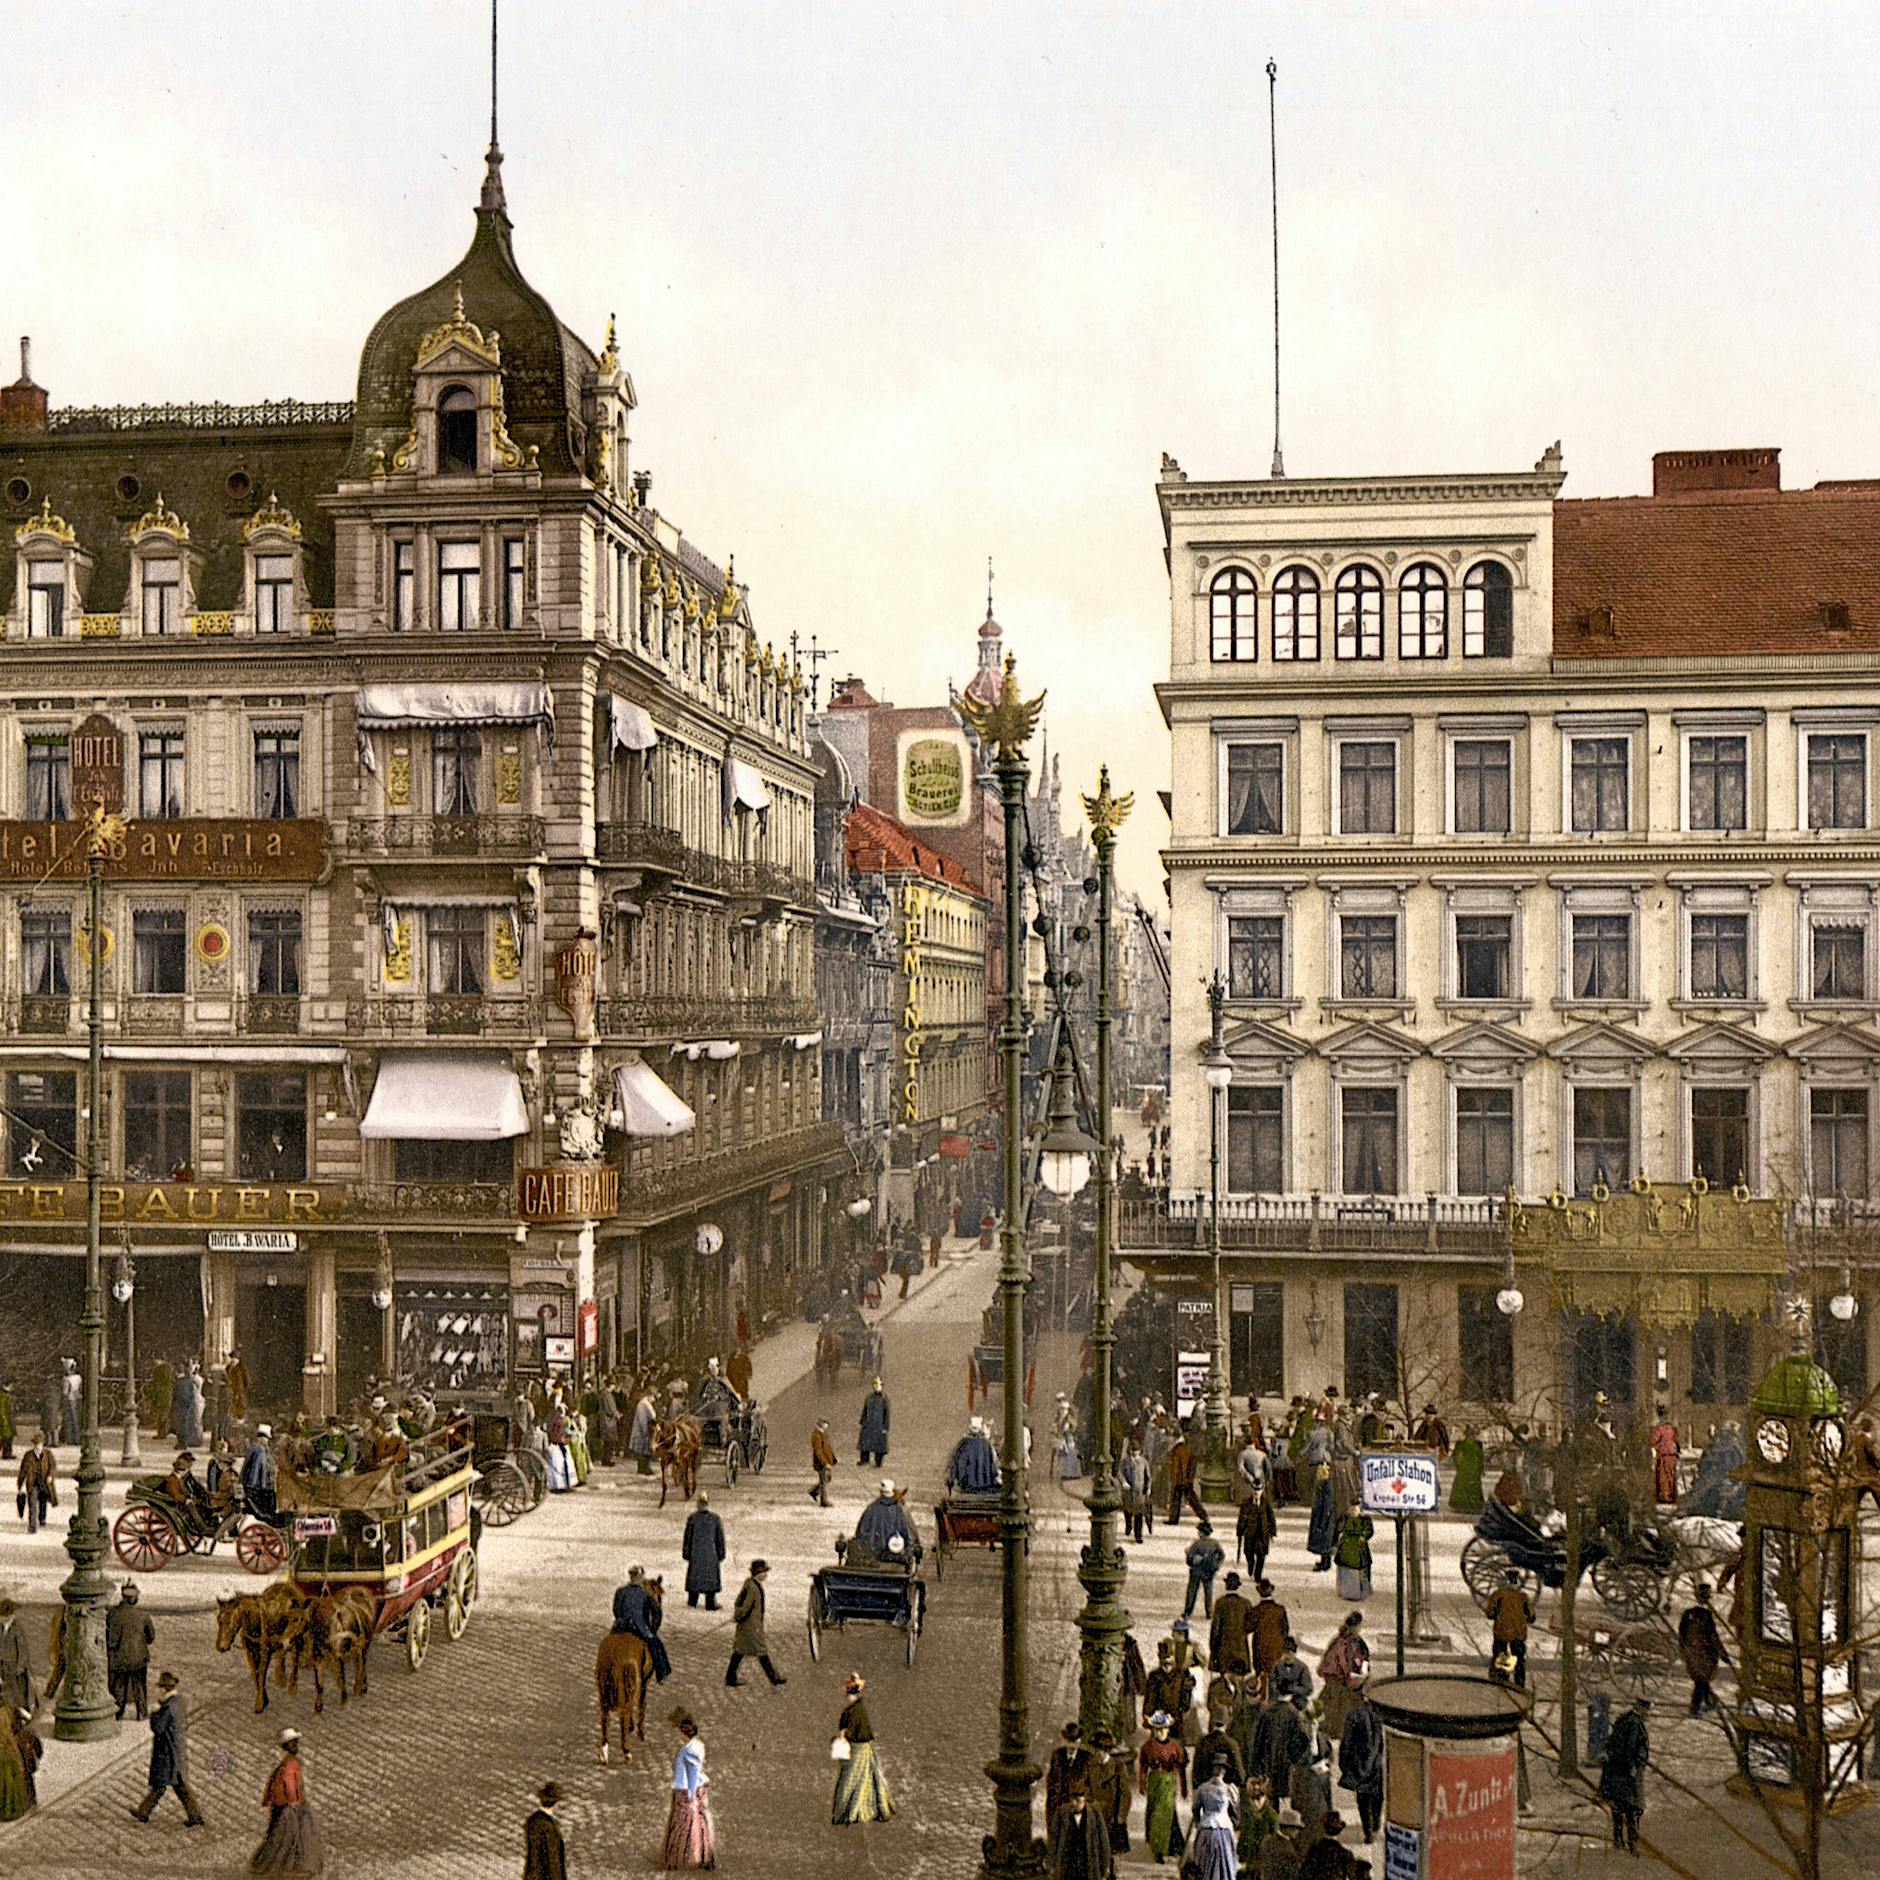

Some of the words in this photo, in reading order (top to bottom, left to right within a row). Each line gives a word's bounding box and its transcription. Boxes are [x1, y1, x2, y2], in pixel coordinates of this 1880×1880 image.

[908, 782, 958, 799] Brauerei
[903, 886, 921, 1121] REMINGTON
[1179, 1303, 1213, 1312] PATRIA
[1367, 1459, 1395, 1482] Unfall
[1397, 1459, 1433, 1485] Station
